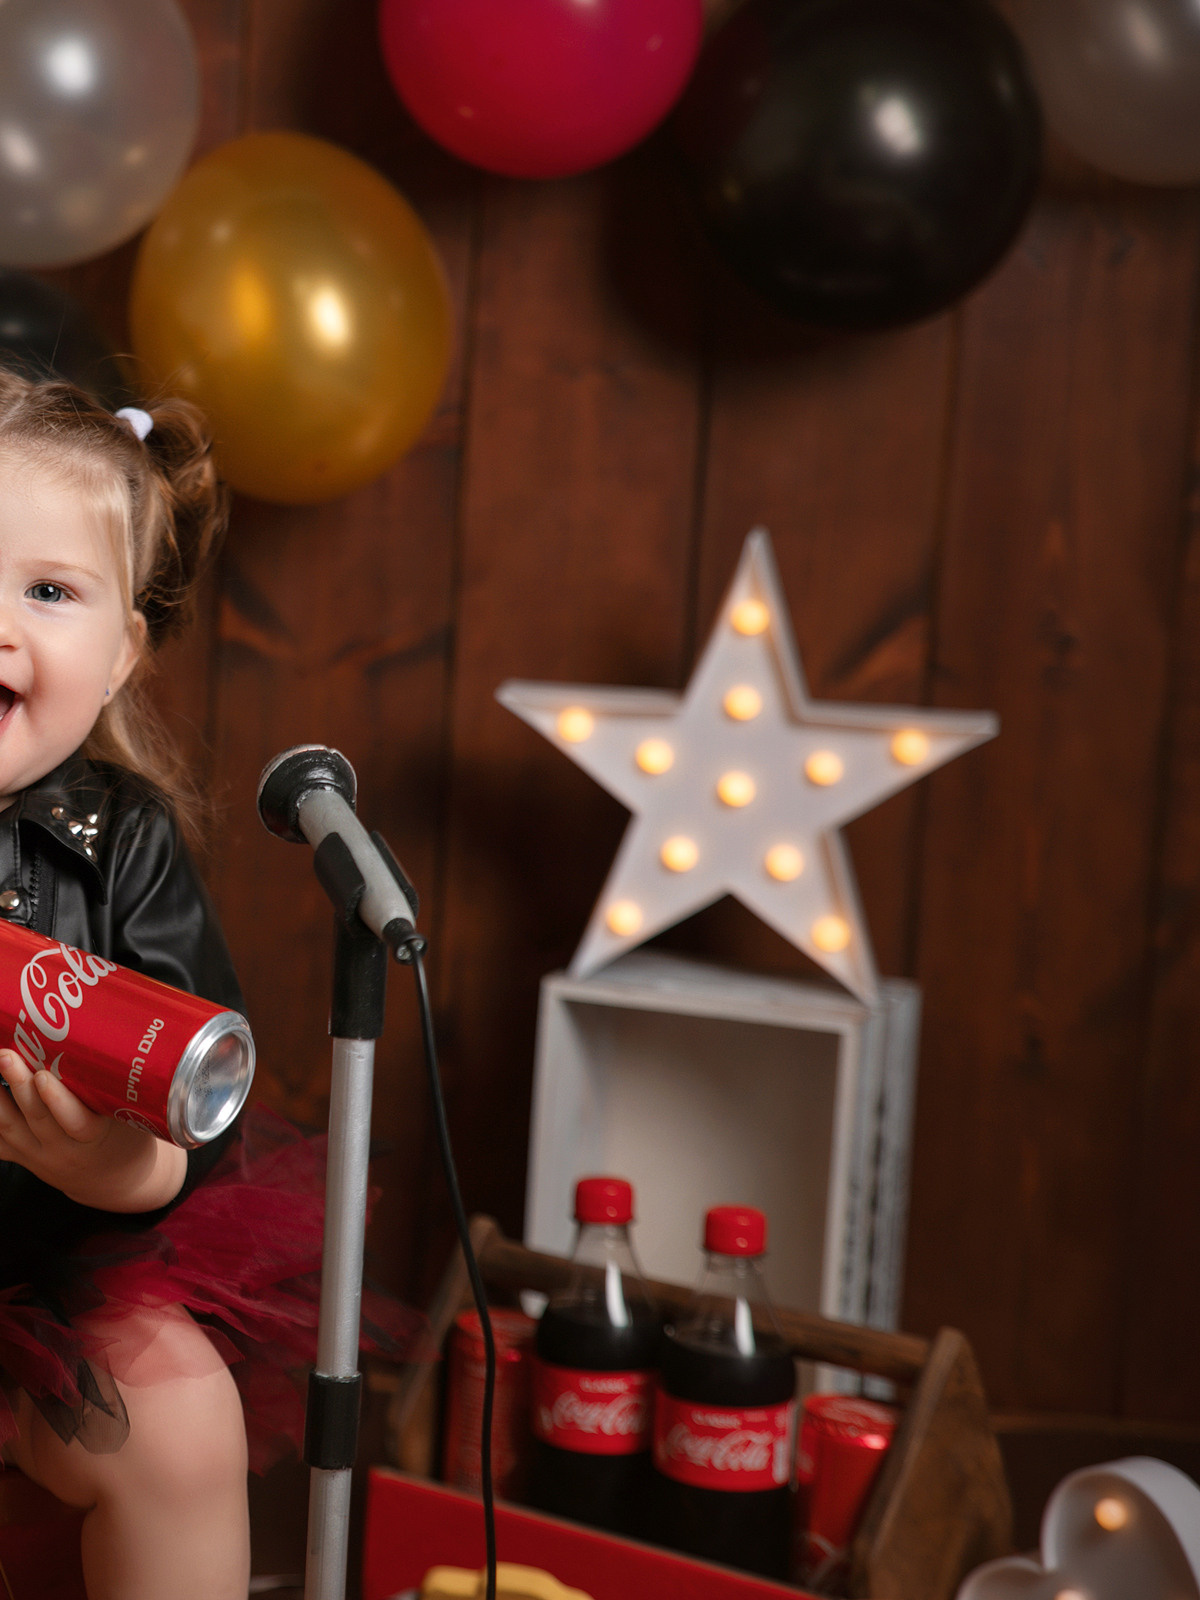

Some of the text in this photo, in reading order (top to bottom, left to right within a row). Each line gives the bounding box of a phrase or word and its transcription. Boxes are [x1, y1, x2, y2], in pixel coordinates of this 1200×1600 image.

[13, 942, 118, 1072] a-Cola
[137, 1018, 165, 1055] טעם
[126, 1056, 146, 1103] החיים
